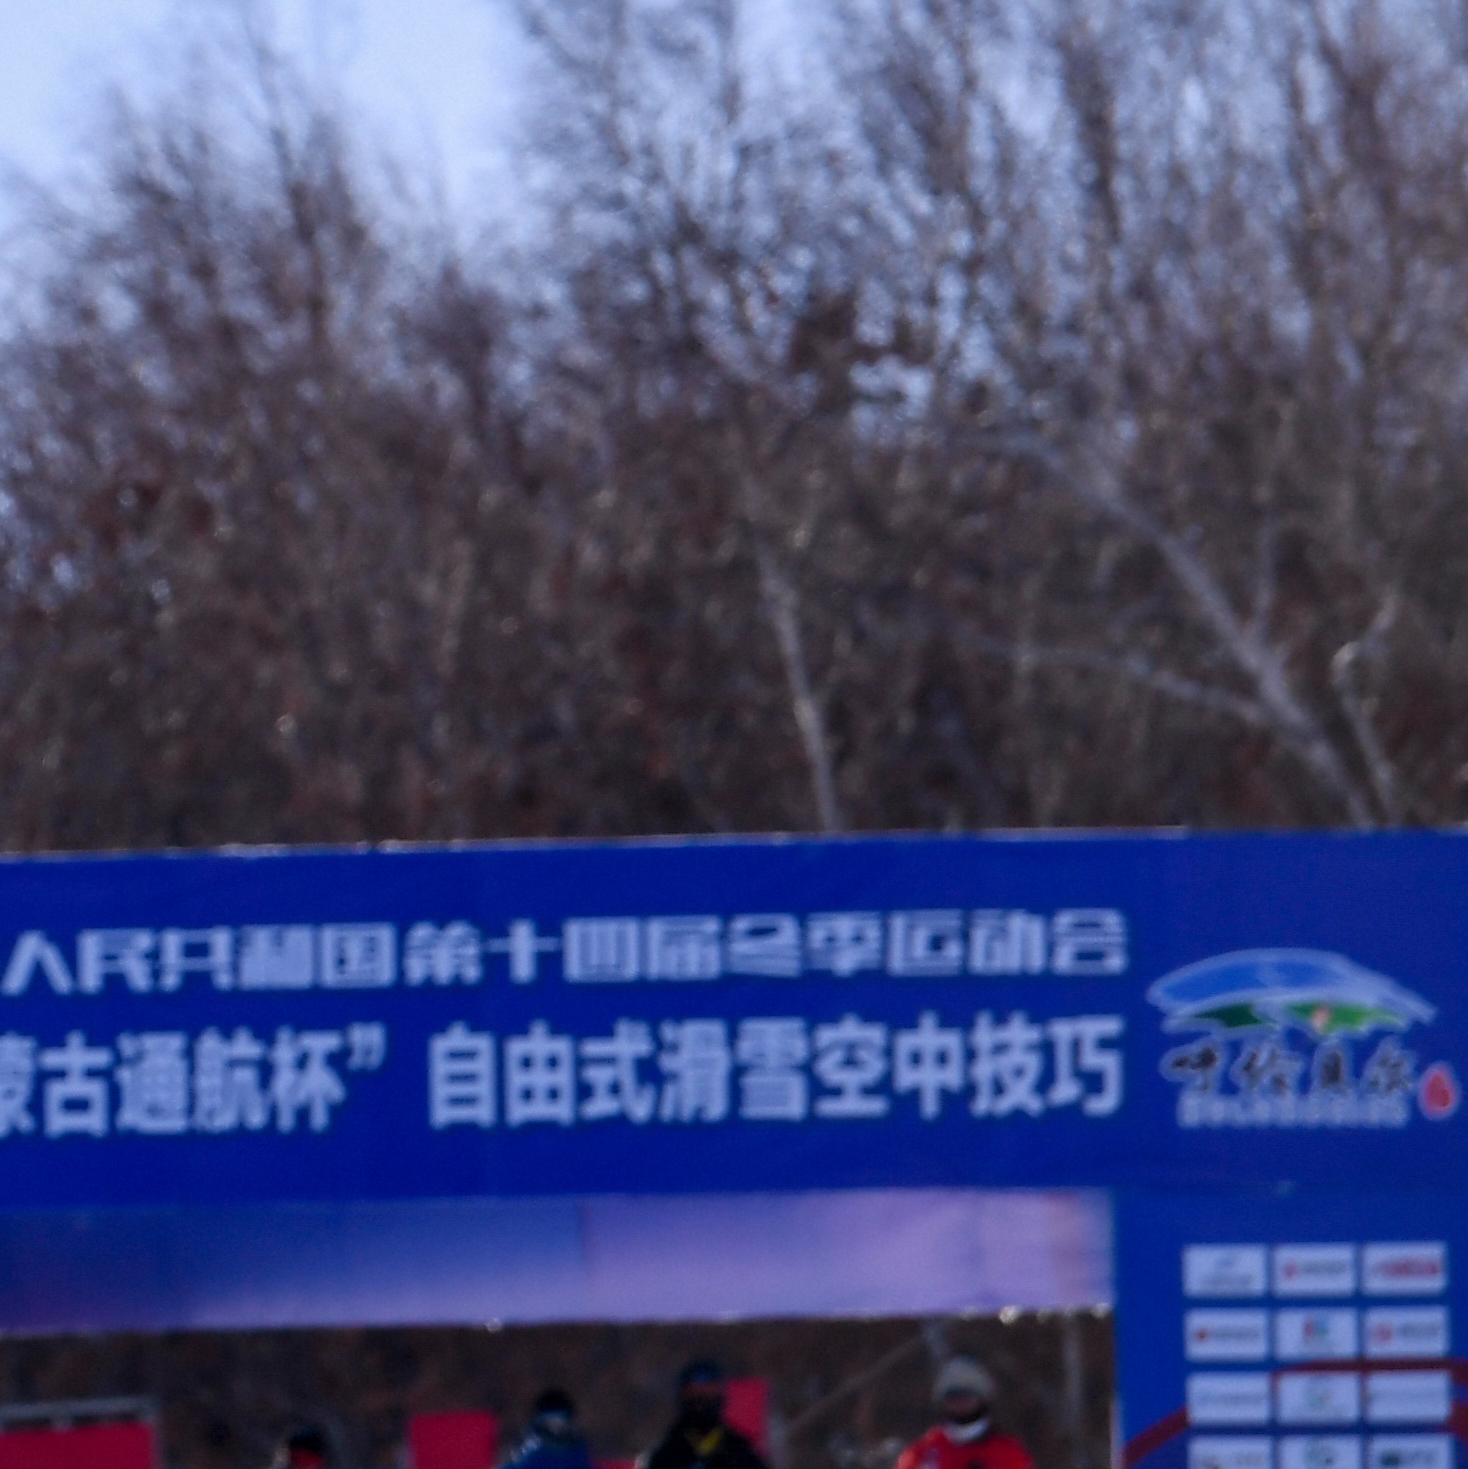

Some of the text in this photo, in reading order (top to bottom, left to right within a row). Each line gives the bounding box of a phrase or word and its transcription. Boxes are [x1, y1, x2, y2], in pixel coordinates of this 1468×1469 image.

[428, 1013, 1123, 1129] 自由式滑雪空中技巧
